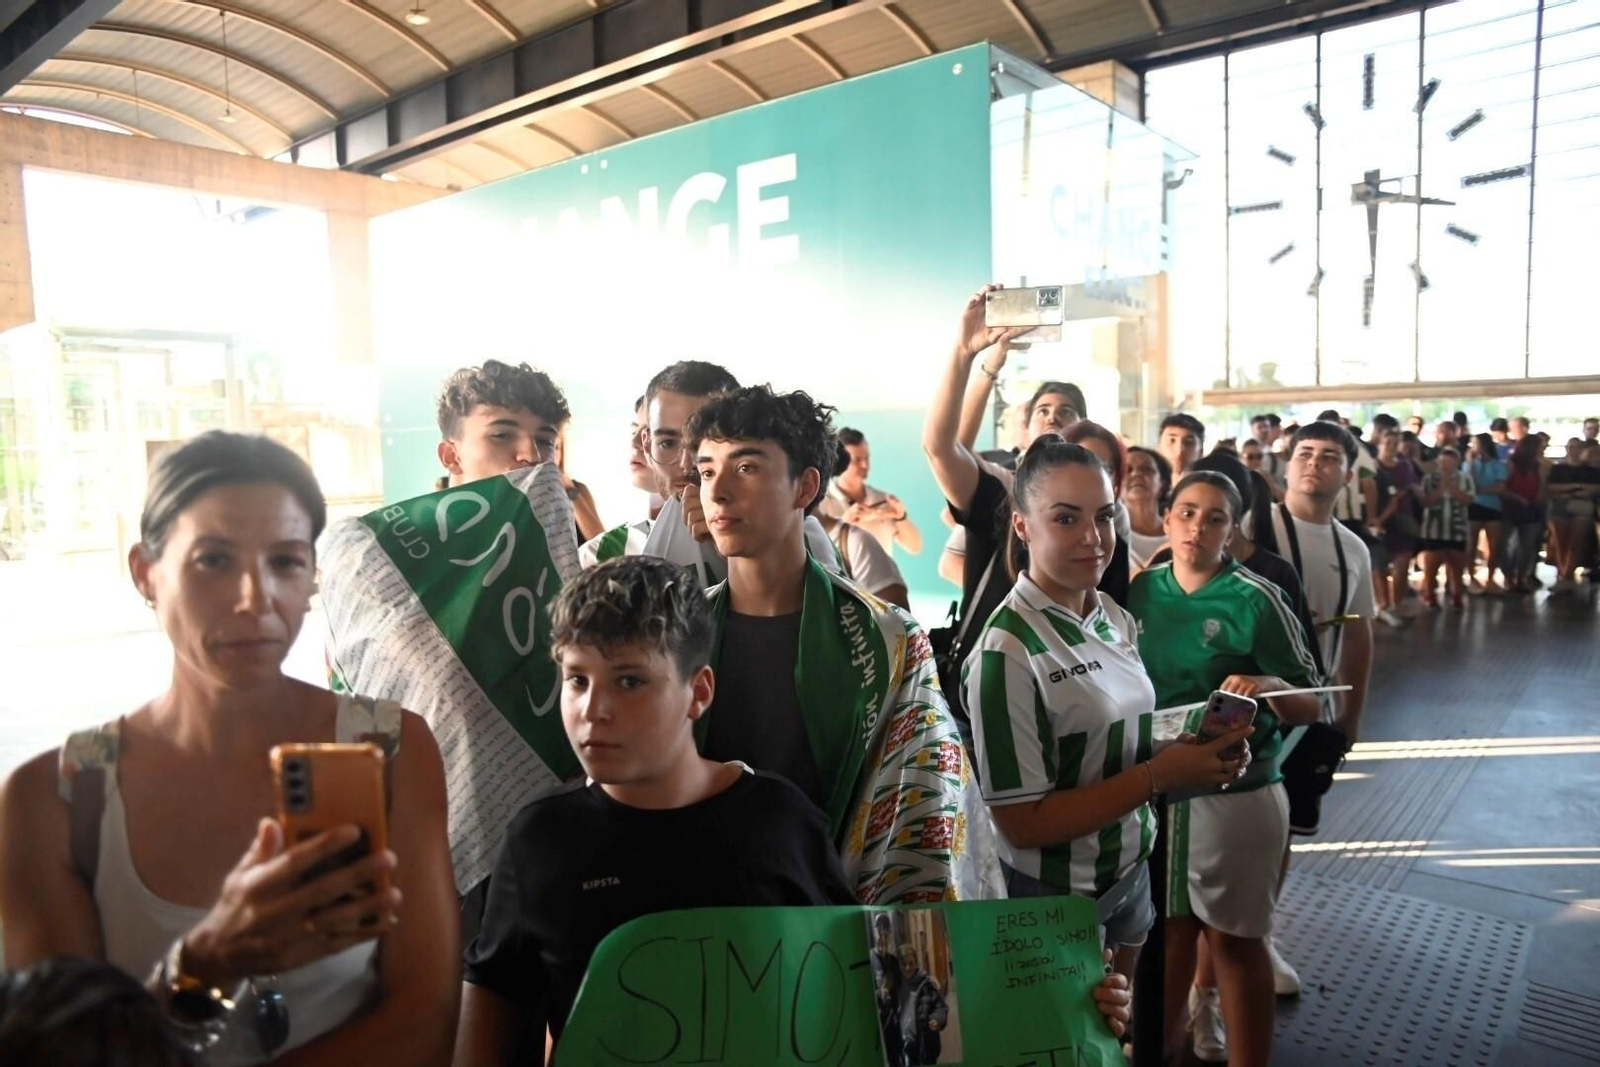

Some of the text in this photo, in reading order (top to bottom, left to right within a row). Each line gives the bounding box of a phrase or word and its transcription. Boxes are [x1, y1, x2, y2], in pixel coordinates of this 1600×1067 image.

[840, 602, 879, 747] ión infinita
[582, 876, 621, 891] KIPSTA
[996, 911, 1038, 933] ERES
